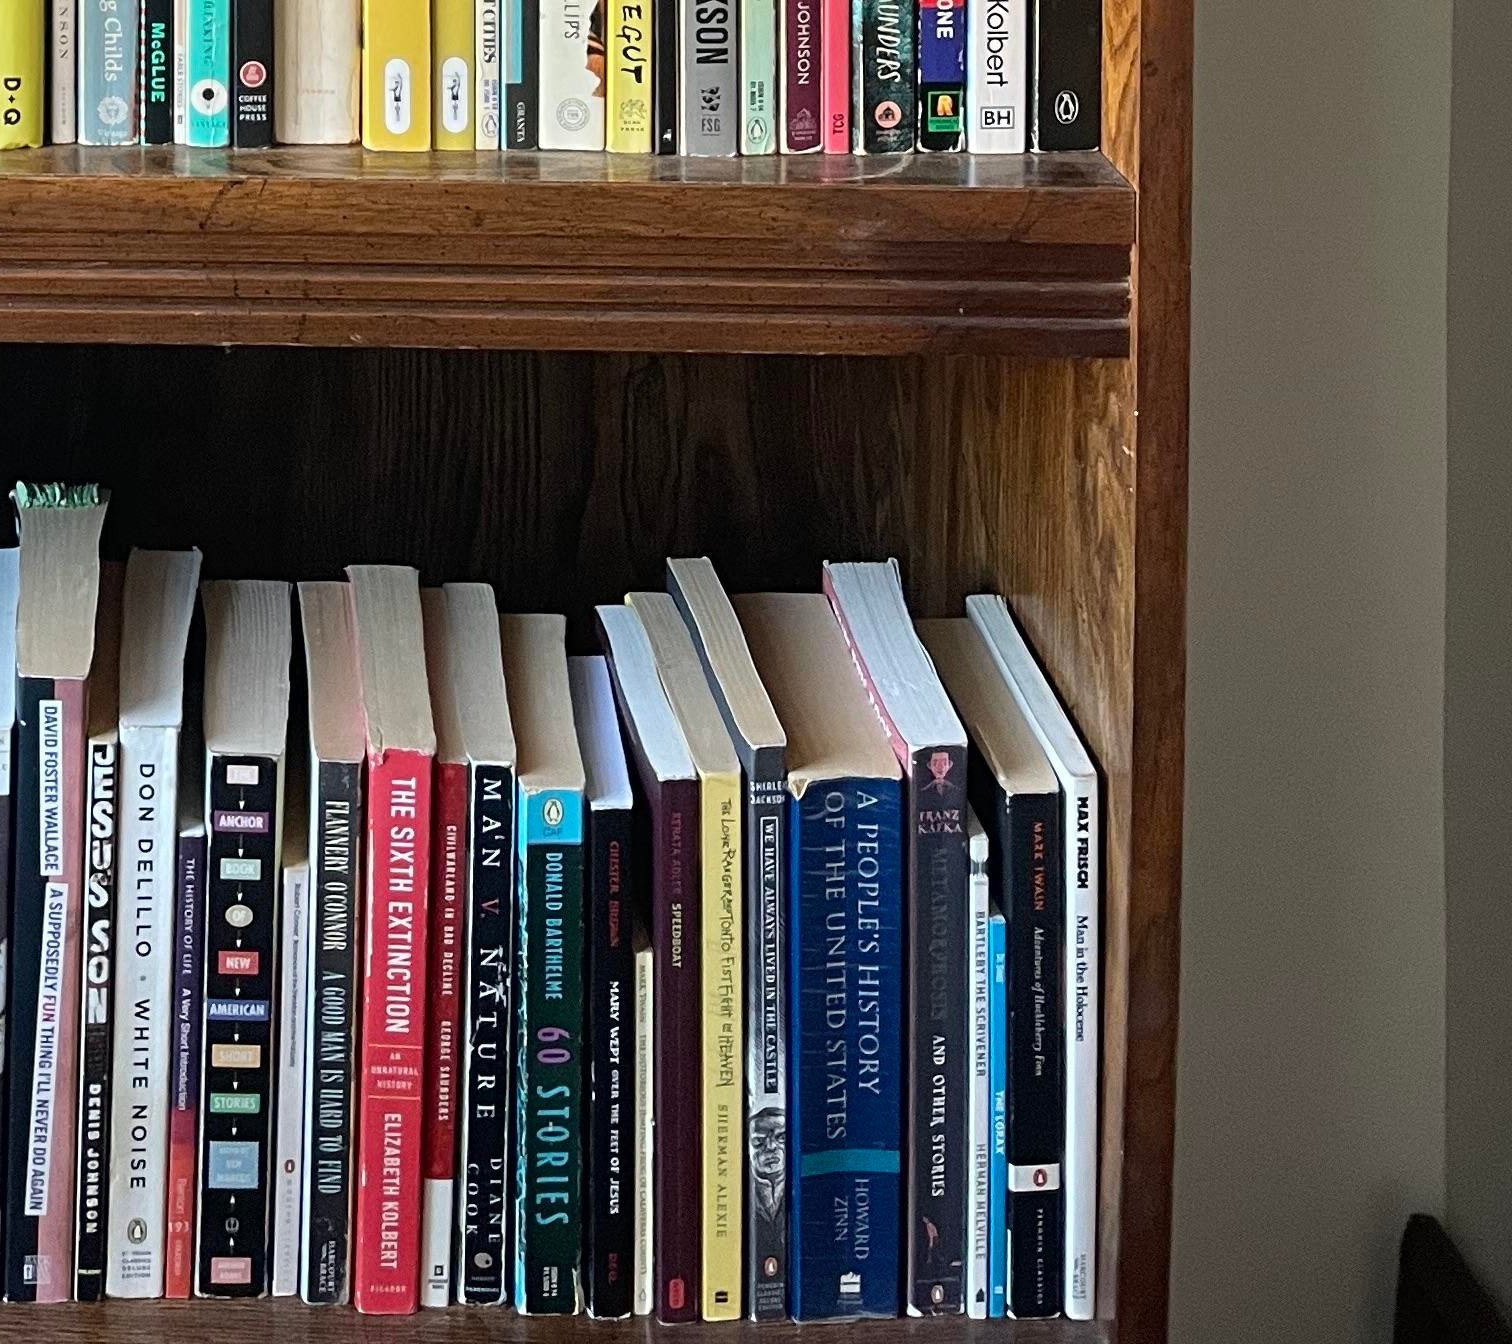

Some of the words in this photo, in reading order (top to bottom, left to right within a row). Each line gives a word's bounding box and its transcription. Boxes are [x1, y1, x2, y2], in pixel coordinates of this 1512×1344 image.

[42, 706, 59, 748] DAVID
[43, 751, 60, 803] FOSTER
[138, 763, 155, 823] DON
[390, 776, 415, 819] THE
[824, 791, 846, 830] OF
[856, 790, 879, 810] A
[43, 805, 61, 871] WALLACE
[389, 826, 415, 895] SIXTH
[824, 839, 847, 902] THE
[134, 838, 153, 959] DELILLO
[544, 851, 564, 911] DONALD
[856, 823, 881, 954] PEOPLE'S
[384, 901, 414, 1033] EXTINCTION
[544, 917, 565, 1001] BARTHELME
[825, 912, 849, 1029] UNITED
[131, 998, 151, 1090] WHITE
[537, 1026, 569, 1064] 60
[856, 963, 882, 1095] HISTORY
[825, 1039, 847, 1140] STATES
[129, 1104, 149, 1191] NOISE
[535, 1084, 571, 1226] STORIES
